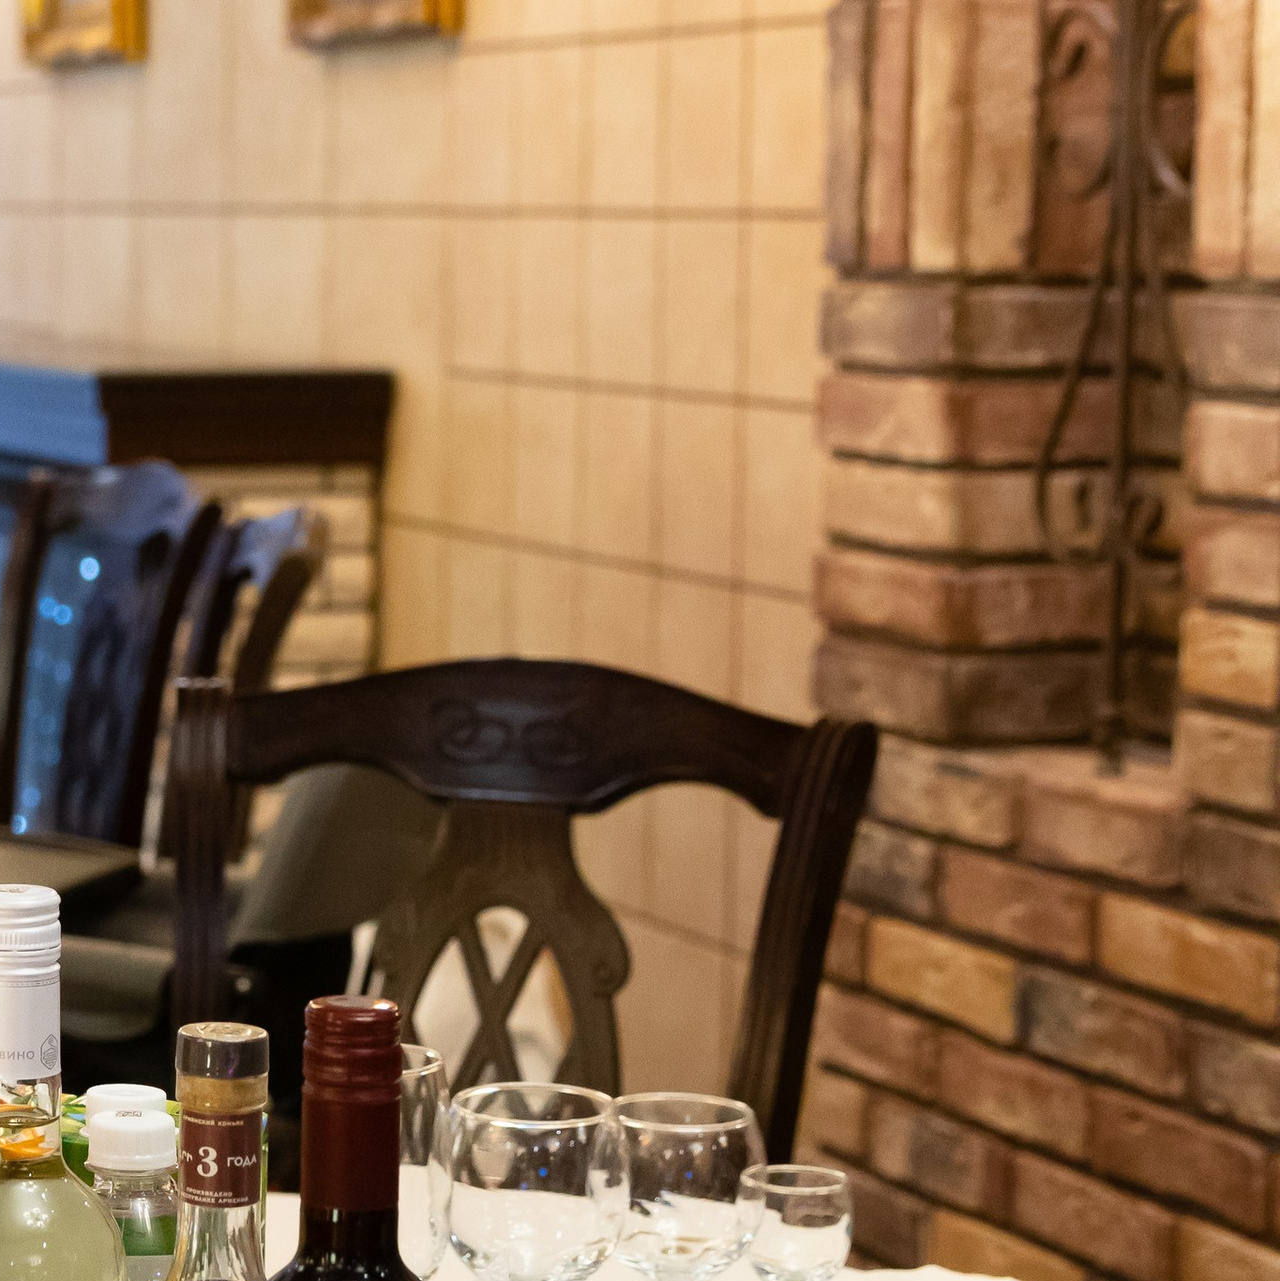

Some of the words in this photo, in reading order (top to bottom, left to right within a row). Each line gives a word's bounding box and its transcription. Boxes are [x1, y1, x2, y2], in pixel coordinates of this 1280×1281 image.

[0, 1050, 35, 1061] ВИНО
[196, 1146, 219, 1178] 3
[227, 1154, 257, 1168] ГОДА
